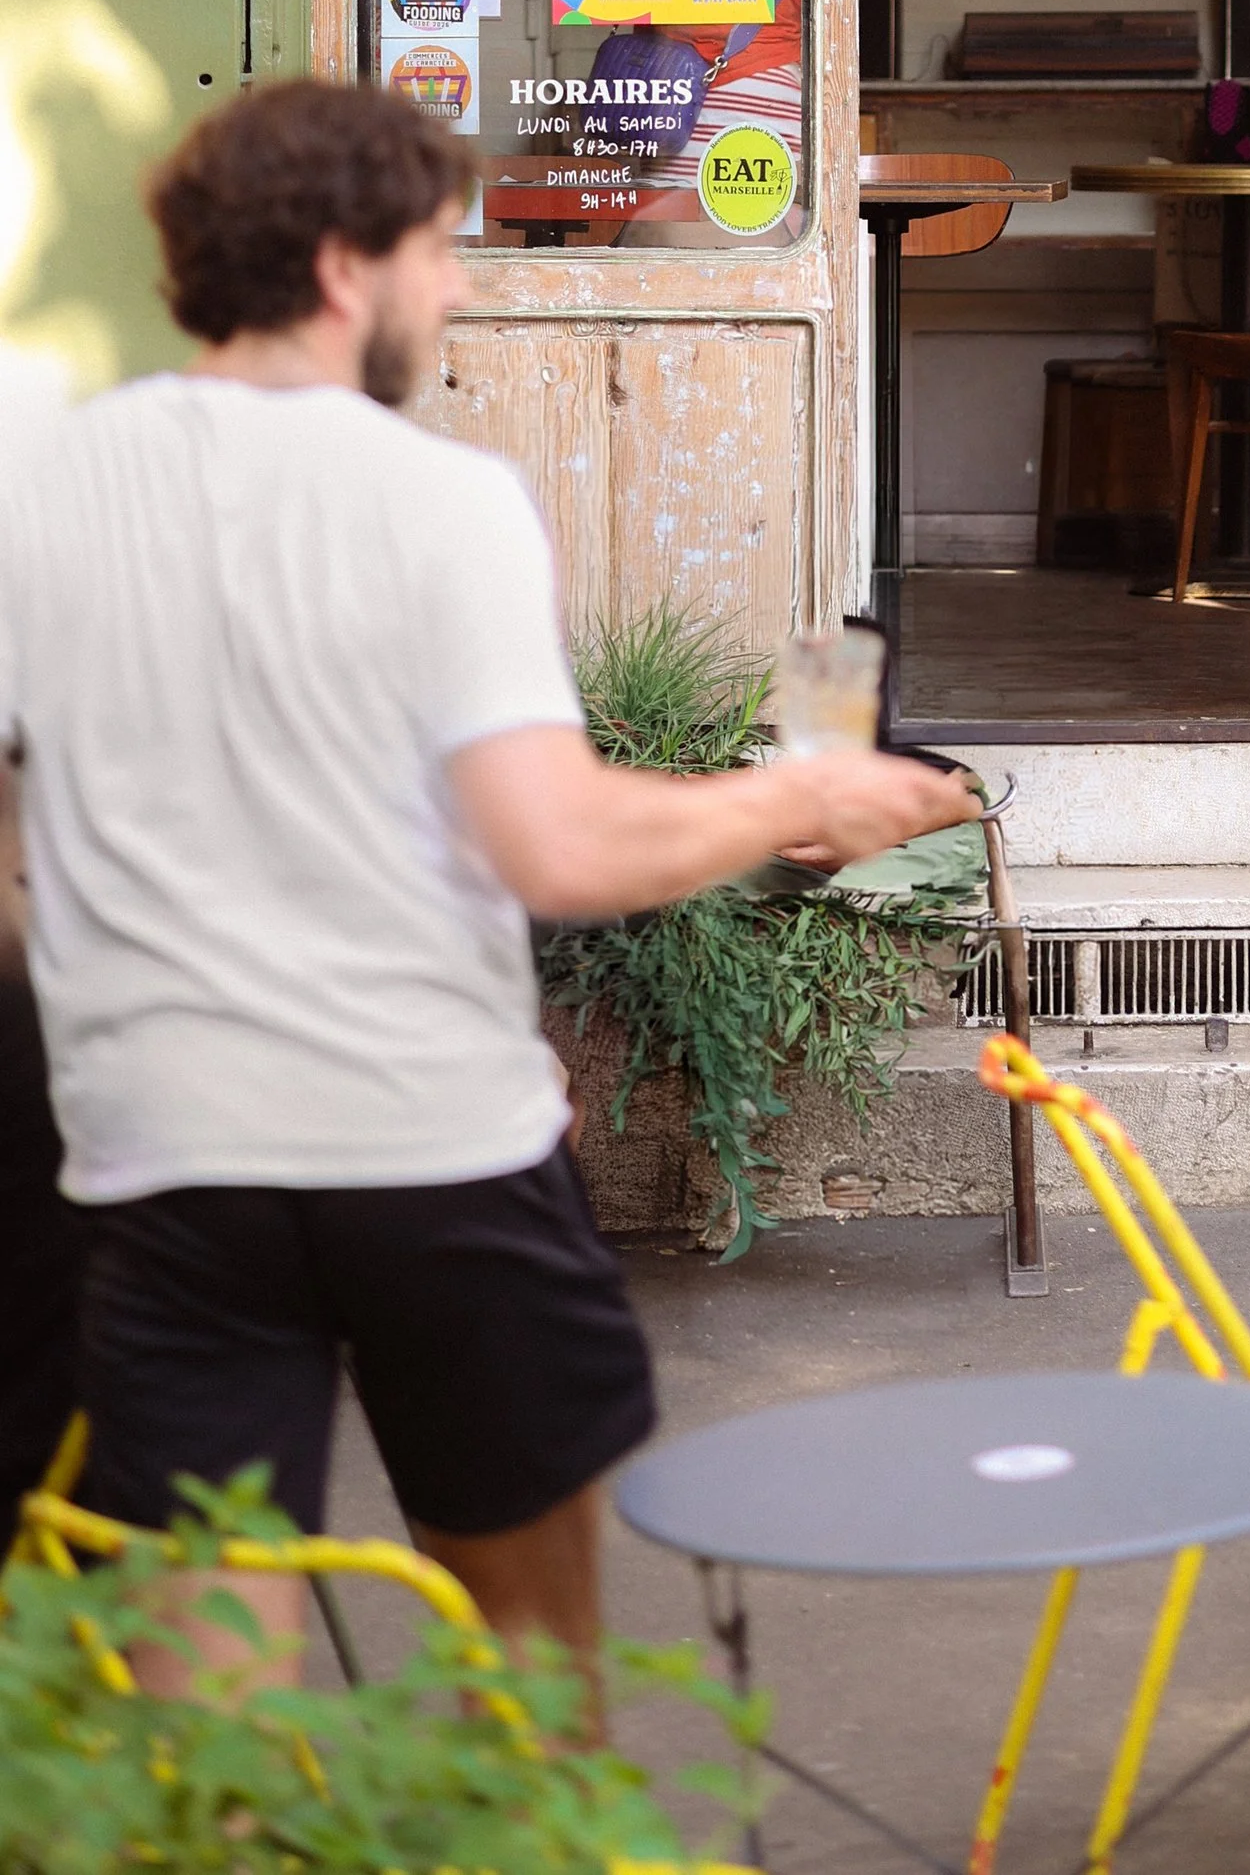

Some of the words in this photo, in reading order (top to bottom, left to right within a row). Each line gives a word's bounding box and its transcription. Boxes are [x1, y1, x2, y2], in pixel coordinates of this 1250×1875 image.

[403, 6, 461, 21] FOODING
[509, 79, 693, 105] HORAIRES
[411, 103, 460, 117] ODING
[584, 116, 608, 133] AU
[711, 126, 751, 149] Recommandé
[713, 158, 773, 182] EAT
[713, 186, 774, 195] MARSEILLE
[710, 207, 727, 225] FOOD
[727, 222, 758, 232] LOVERS
[759, 210, 782, 230] TRAVEL
